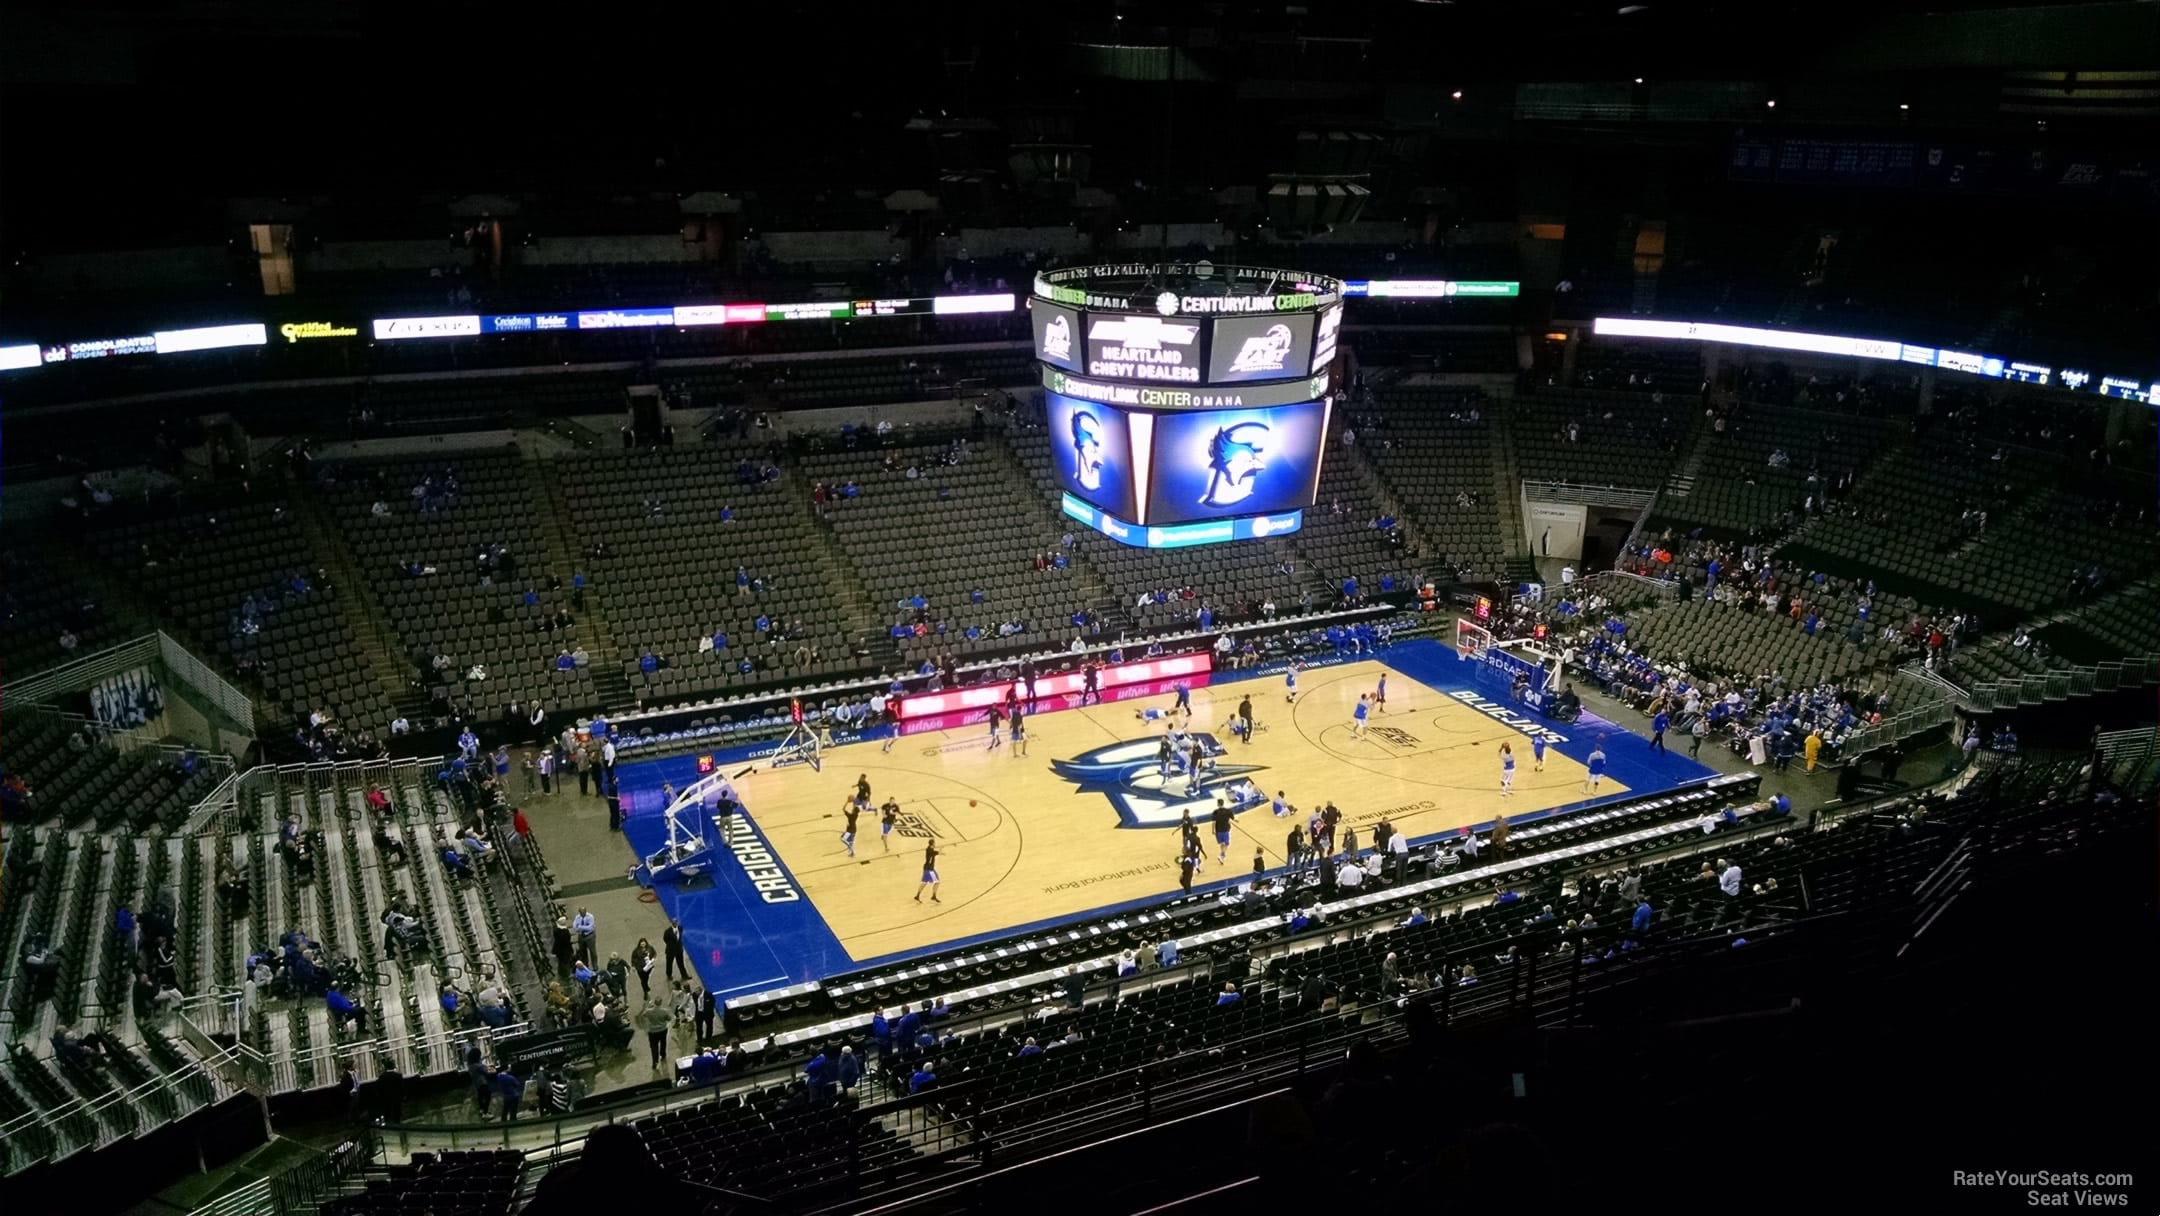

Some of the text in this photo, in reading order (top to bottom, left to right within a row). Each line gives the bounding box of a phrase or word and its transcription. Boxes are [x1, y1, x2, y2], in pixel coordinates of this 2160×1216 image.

[1181, 292, 1316, 312] CENTURYLINK CENTER
[70, 336, 155, 353] CONSOLIDATED
[1102, 346, 1182, 364] HEARTLAND
[1090, 361, 1200, 382] CHEVY DEALERS
[1064, 378, 1242, 406] CENTURYLINK CENTER OMAHA
[1449, 691, 1570, 744] BLUEJAYS
[1041, 861, 1171, 894] First National Bank
[520, 1045, 564, 1060] CENTURYLINK
